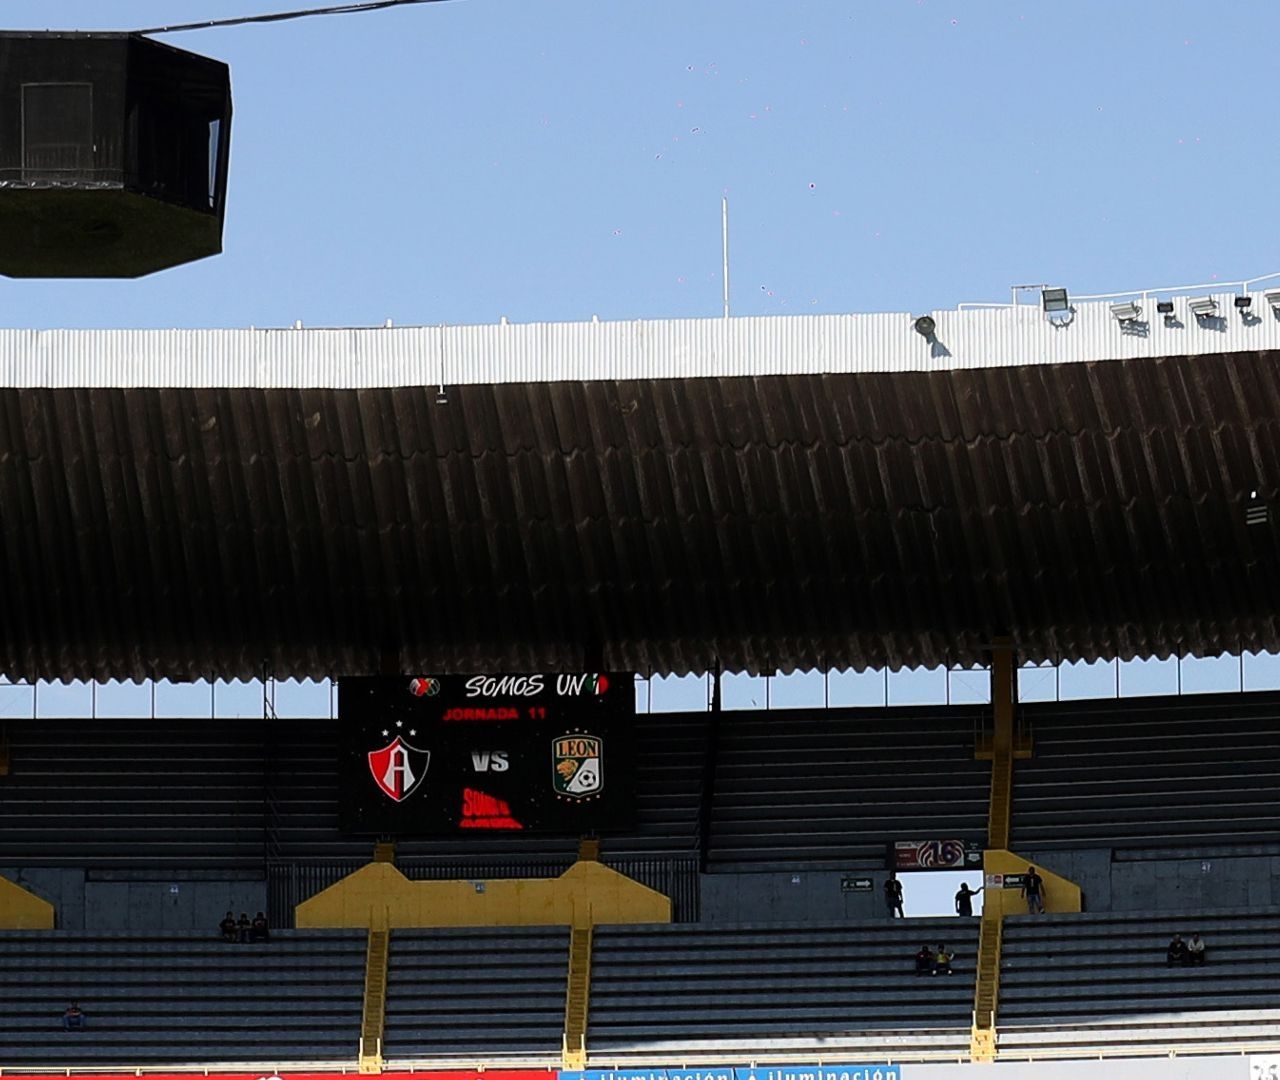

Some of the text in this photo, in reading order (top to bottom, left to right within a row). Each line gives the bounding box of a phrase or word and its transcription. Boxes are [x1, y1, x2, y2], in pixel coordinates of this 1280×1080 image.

[465, 674, 545, 697] SOMOS
[443, 707, 547, 721] JORNADA 11
[471, 751, 510, 772] VS
